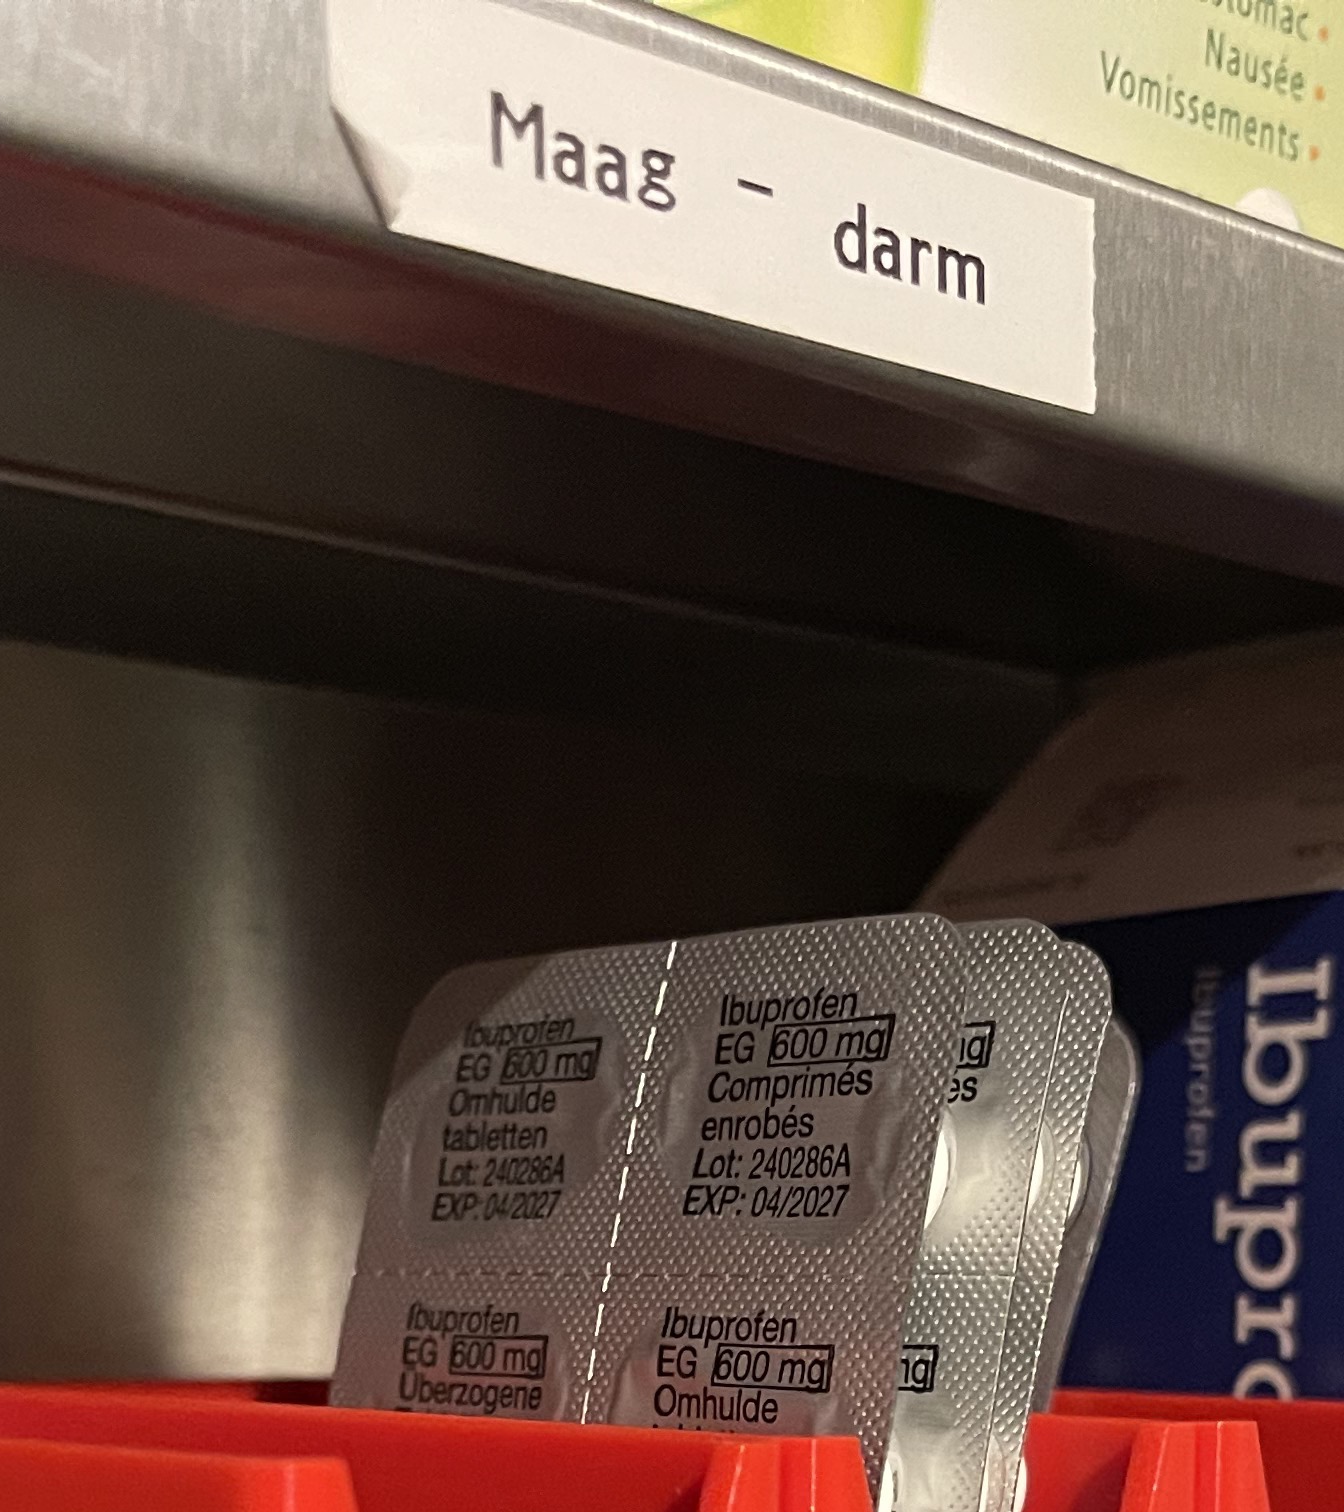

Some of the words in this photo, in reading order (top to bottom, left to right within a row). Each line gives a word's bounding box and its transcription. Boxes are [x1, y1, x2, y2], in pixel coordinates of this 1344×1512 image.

[1205, 28, 1306, 102] Nausée
[1100, 50, 1301, 162] Vomissements
[488, 89, 679, 213] Maag
[737, 177, 774, 197] -
[833, 202, 989, 306] darm
[718, 986, 858, 1030] Ibuprofen
[463, 1014, 575, 1049] Ibuprofen
[714, 1031, 755, 1066] EG
[770, 1028, 827, 1060] 600
[834, 1026, 886, 1064] mg
[457, 1052, 493, 1082] EG
[503, 1049, 548, 1079] 600
[556, 1050, 594, 1080] mg
[707, 1064, 874, 1106] Comprimés
[1186, 967, 1224, 1172] Ibuprofen
[449, 1085, 556, 1118] Omhulde
[442, 1125, 548, 1154] tabletten
[701, 1106, 815, 1142] enrobés
[438, 1156, 472, 1187] Lot:
[483, 1154, 565, 1188] 240286A
[692, 1149, 740, 1180] Lot:
[748, 1143, 851, 1181] 240286A
[432, 1191, 478, 1221] EXP:
[484, 1190, 561, 1220] 04/2027
[682, 1185, 747, 1218] EXP:
[750, 1184, 850, 1219] 04/2027
[408, 1303, 520, 1340] Ibuprofen
[661, 1306, 798, 1349] Ibuprofen
[403, 1336, 437, 1367] EG
[452, 1341, 495, 1370] 600
[503, 1347, 542, 1378] mg
[657, 1344, 698, 1379] EG
[716, 1348, 770, 1382] 600
[777, 1357, 827, 1392] mg
[654, 1384, 778, 1423] Omhulde
